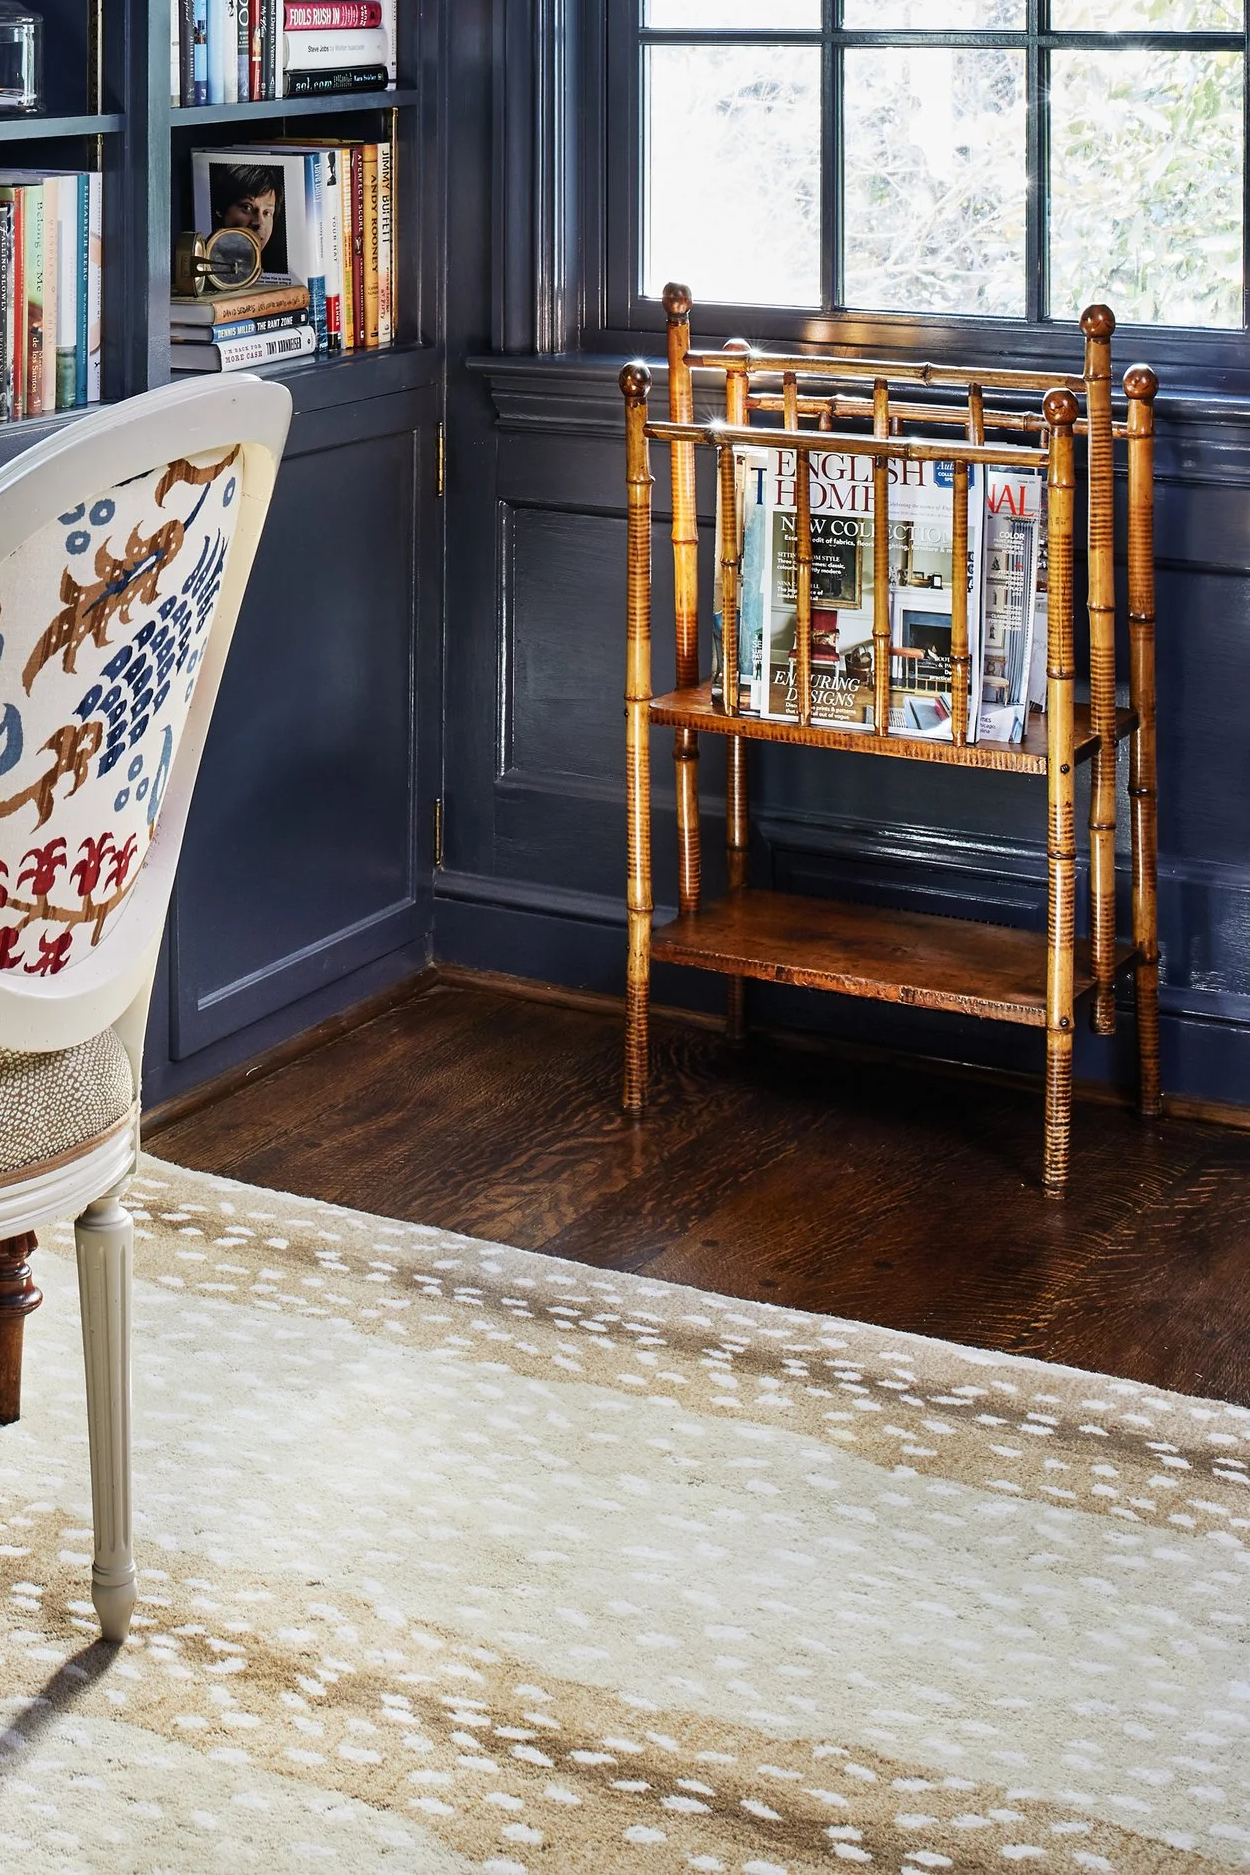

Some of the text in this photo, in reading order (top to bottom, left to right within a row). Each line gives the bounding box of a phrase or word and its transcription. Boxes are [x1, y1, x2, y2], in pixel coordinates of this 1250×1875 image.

[290, 8, 312, 26] FOOLS
[312, 7, 332, 25] RUSH
[332, 7, 340, 24] IN
[270, 35, 276, 43] in
[308, 45, 319, 53] Steve
[295, 76, 332, 92] aol.com
[370, 174, 378, 213] ANDY
[381, 150, 390, 243] JIMMY BUFFETT
[34, 201, 43, 293] Belong to Me
[222, 304, 256, 318] DAVID SEDARIS
[217, 323, 255, 339] DENNIS MILLER
[257, 316, 293, 331] THE RANT ZONE
[32, 336, 39, 348] de
[234, 346, 248, 354] BACK
[265, 336, 302, 356] TONY KORNHEISER
[225, 350, 263, 364] MORE CASH
[31, 363, 39, 394] Santos
[781, 516, 826, 535] NW
[812, 537, 856, 547] edit of fabrics,
[999, 531, 1025, 540] COLOR
[773, 670, 860, 692] ENURING
[785, 687, 855, 707] DSIGNS
